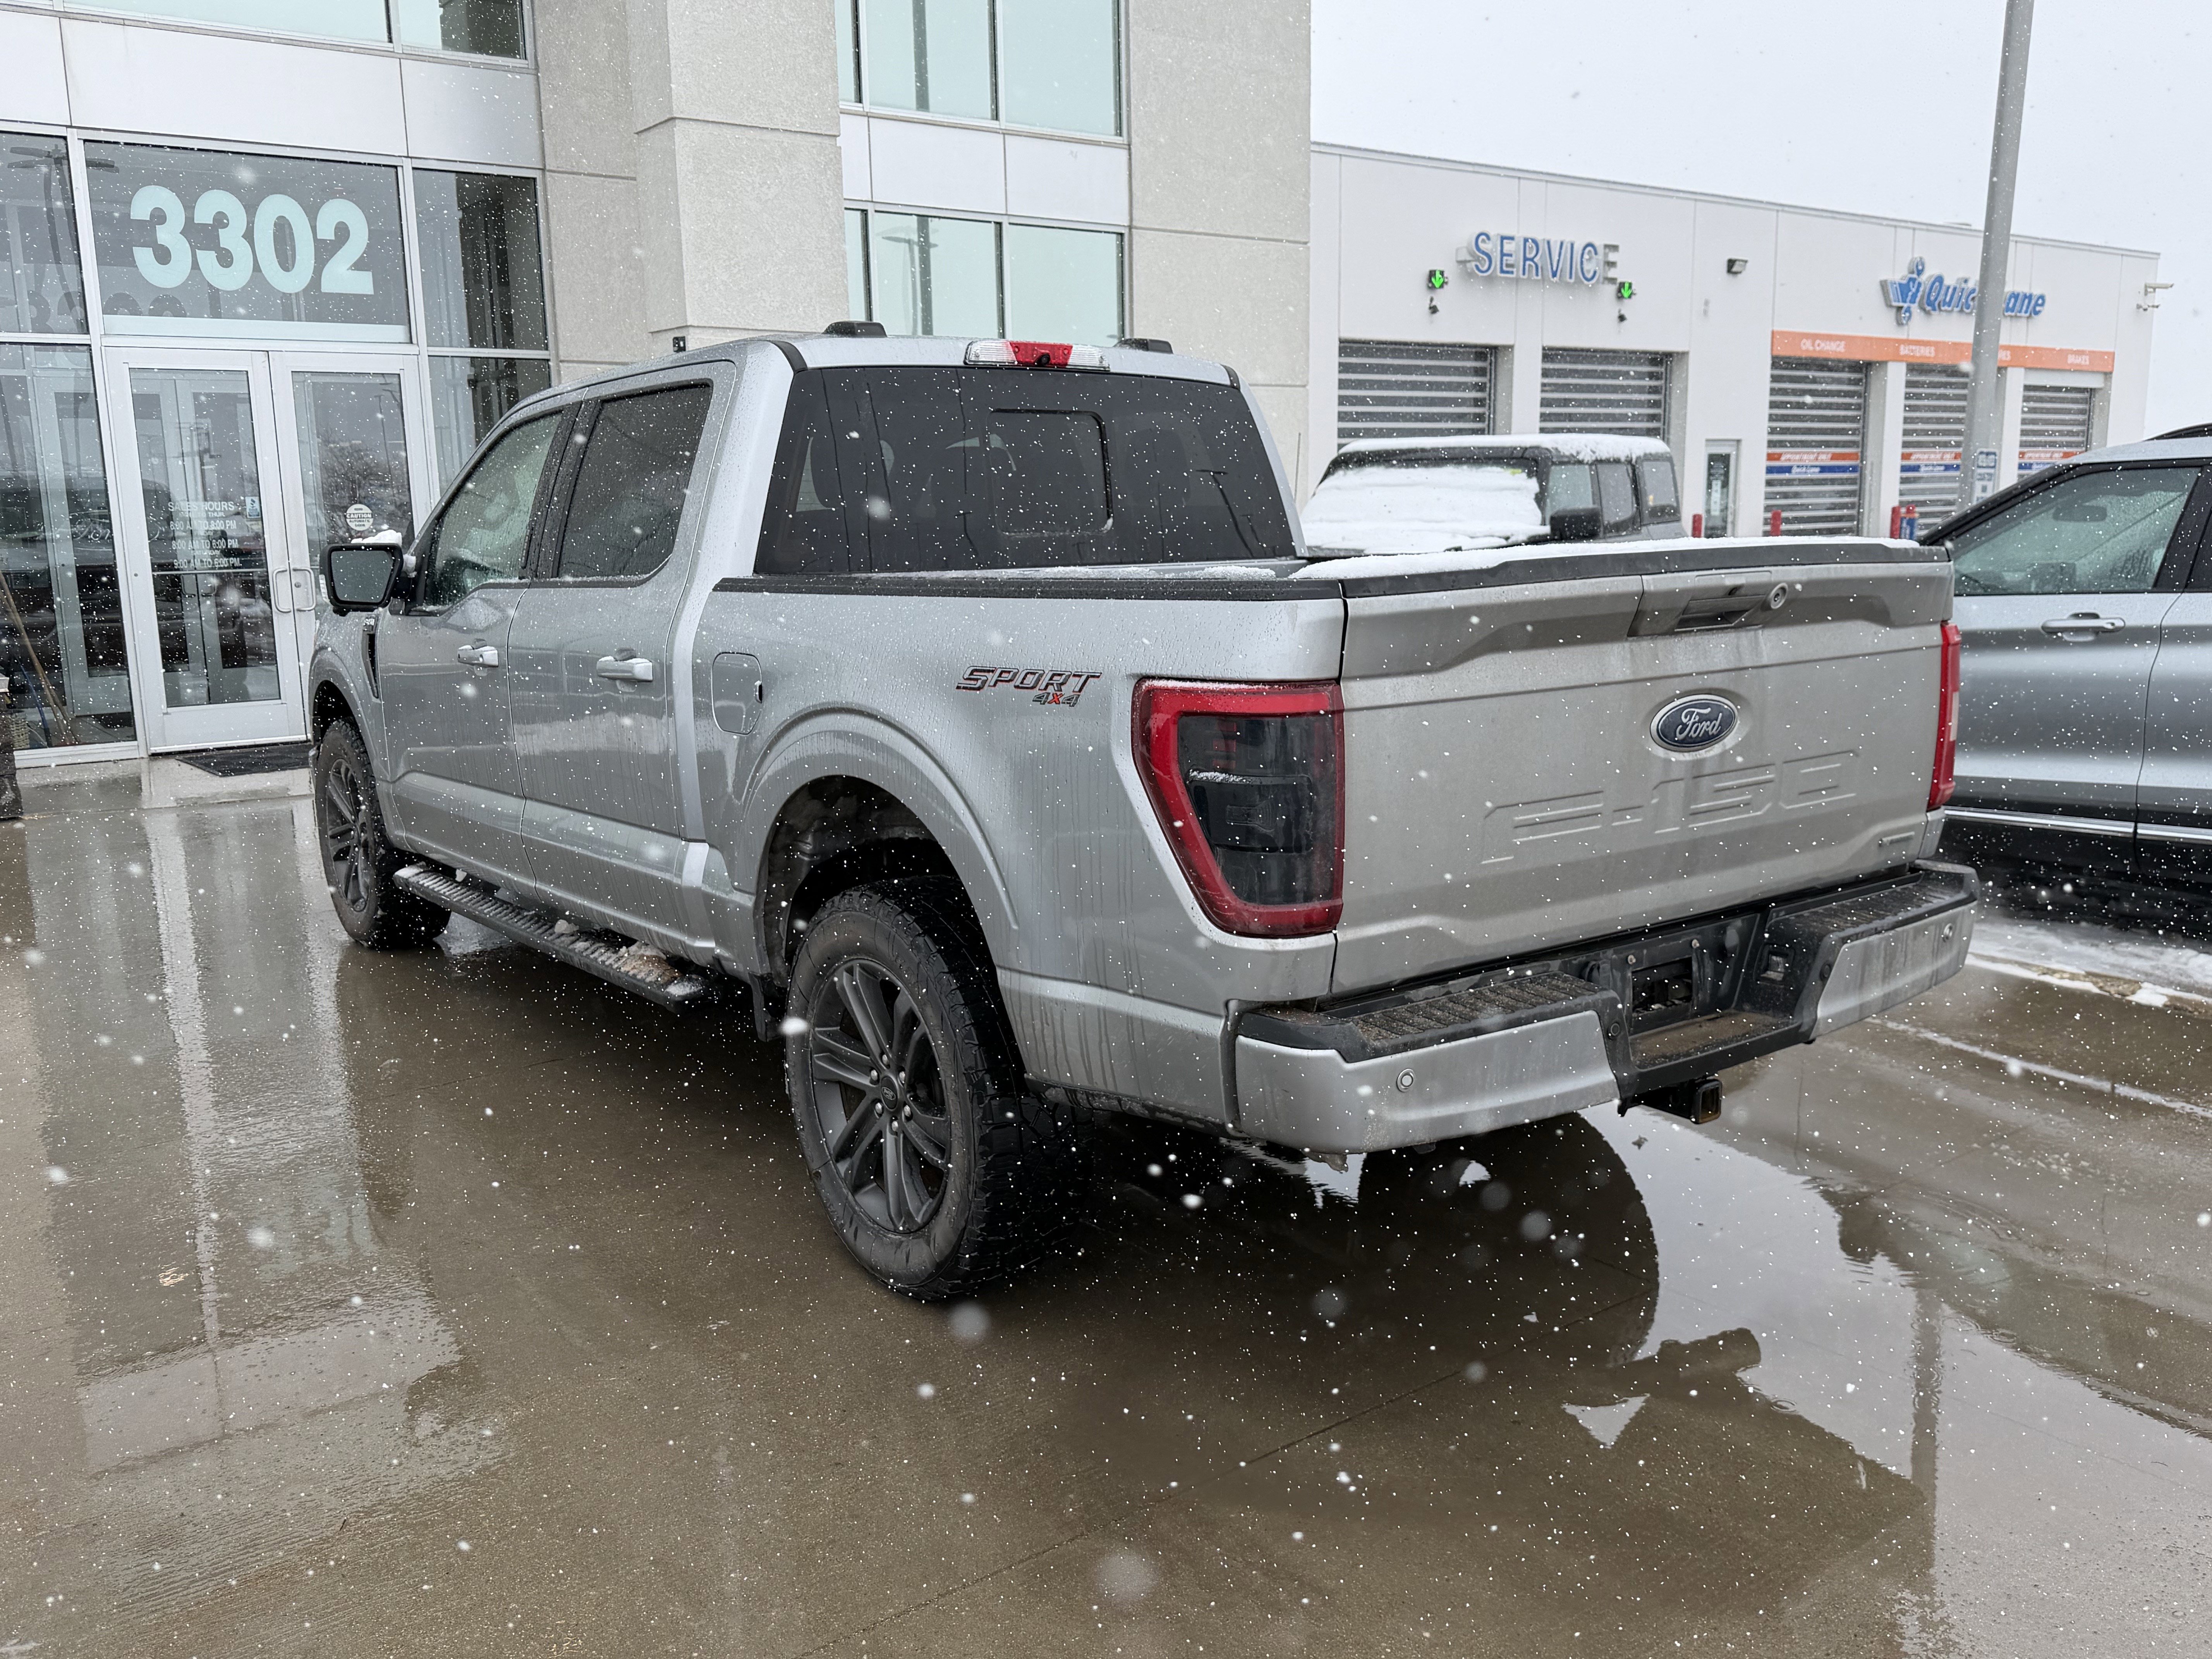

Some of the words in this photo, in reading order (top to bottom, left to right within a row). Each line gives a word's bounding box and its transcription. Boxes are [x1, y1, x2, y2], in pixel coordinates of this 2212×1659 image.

[131, 185, 374, 295] 3302
[1472, 231, 1620, 285] SERVICE
[1923, 272, 1978, 313] Quic
[2003, 290, 2046, 318] ane
[168, 501, 198, 512] SALES
[202, 501, 235, 511] HOURS
[226, 520, 237, 529] PM
[202, 539, 211, 549] TO
[227, 538, 239, 548] PM
[203, 558, 213, 568] TO
[955, 665, 1103, 691] SPORT
[1676, 707, 1723, 740] Ford
[1480, 749, 1860, 865] F-150
